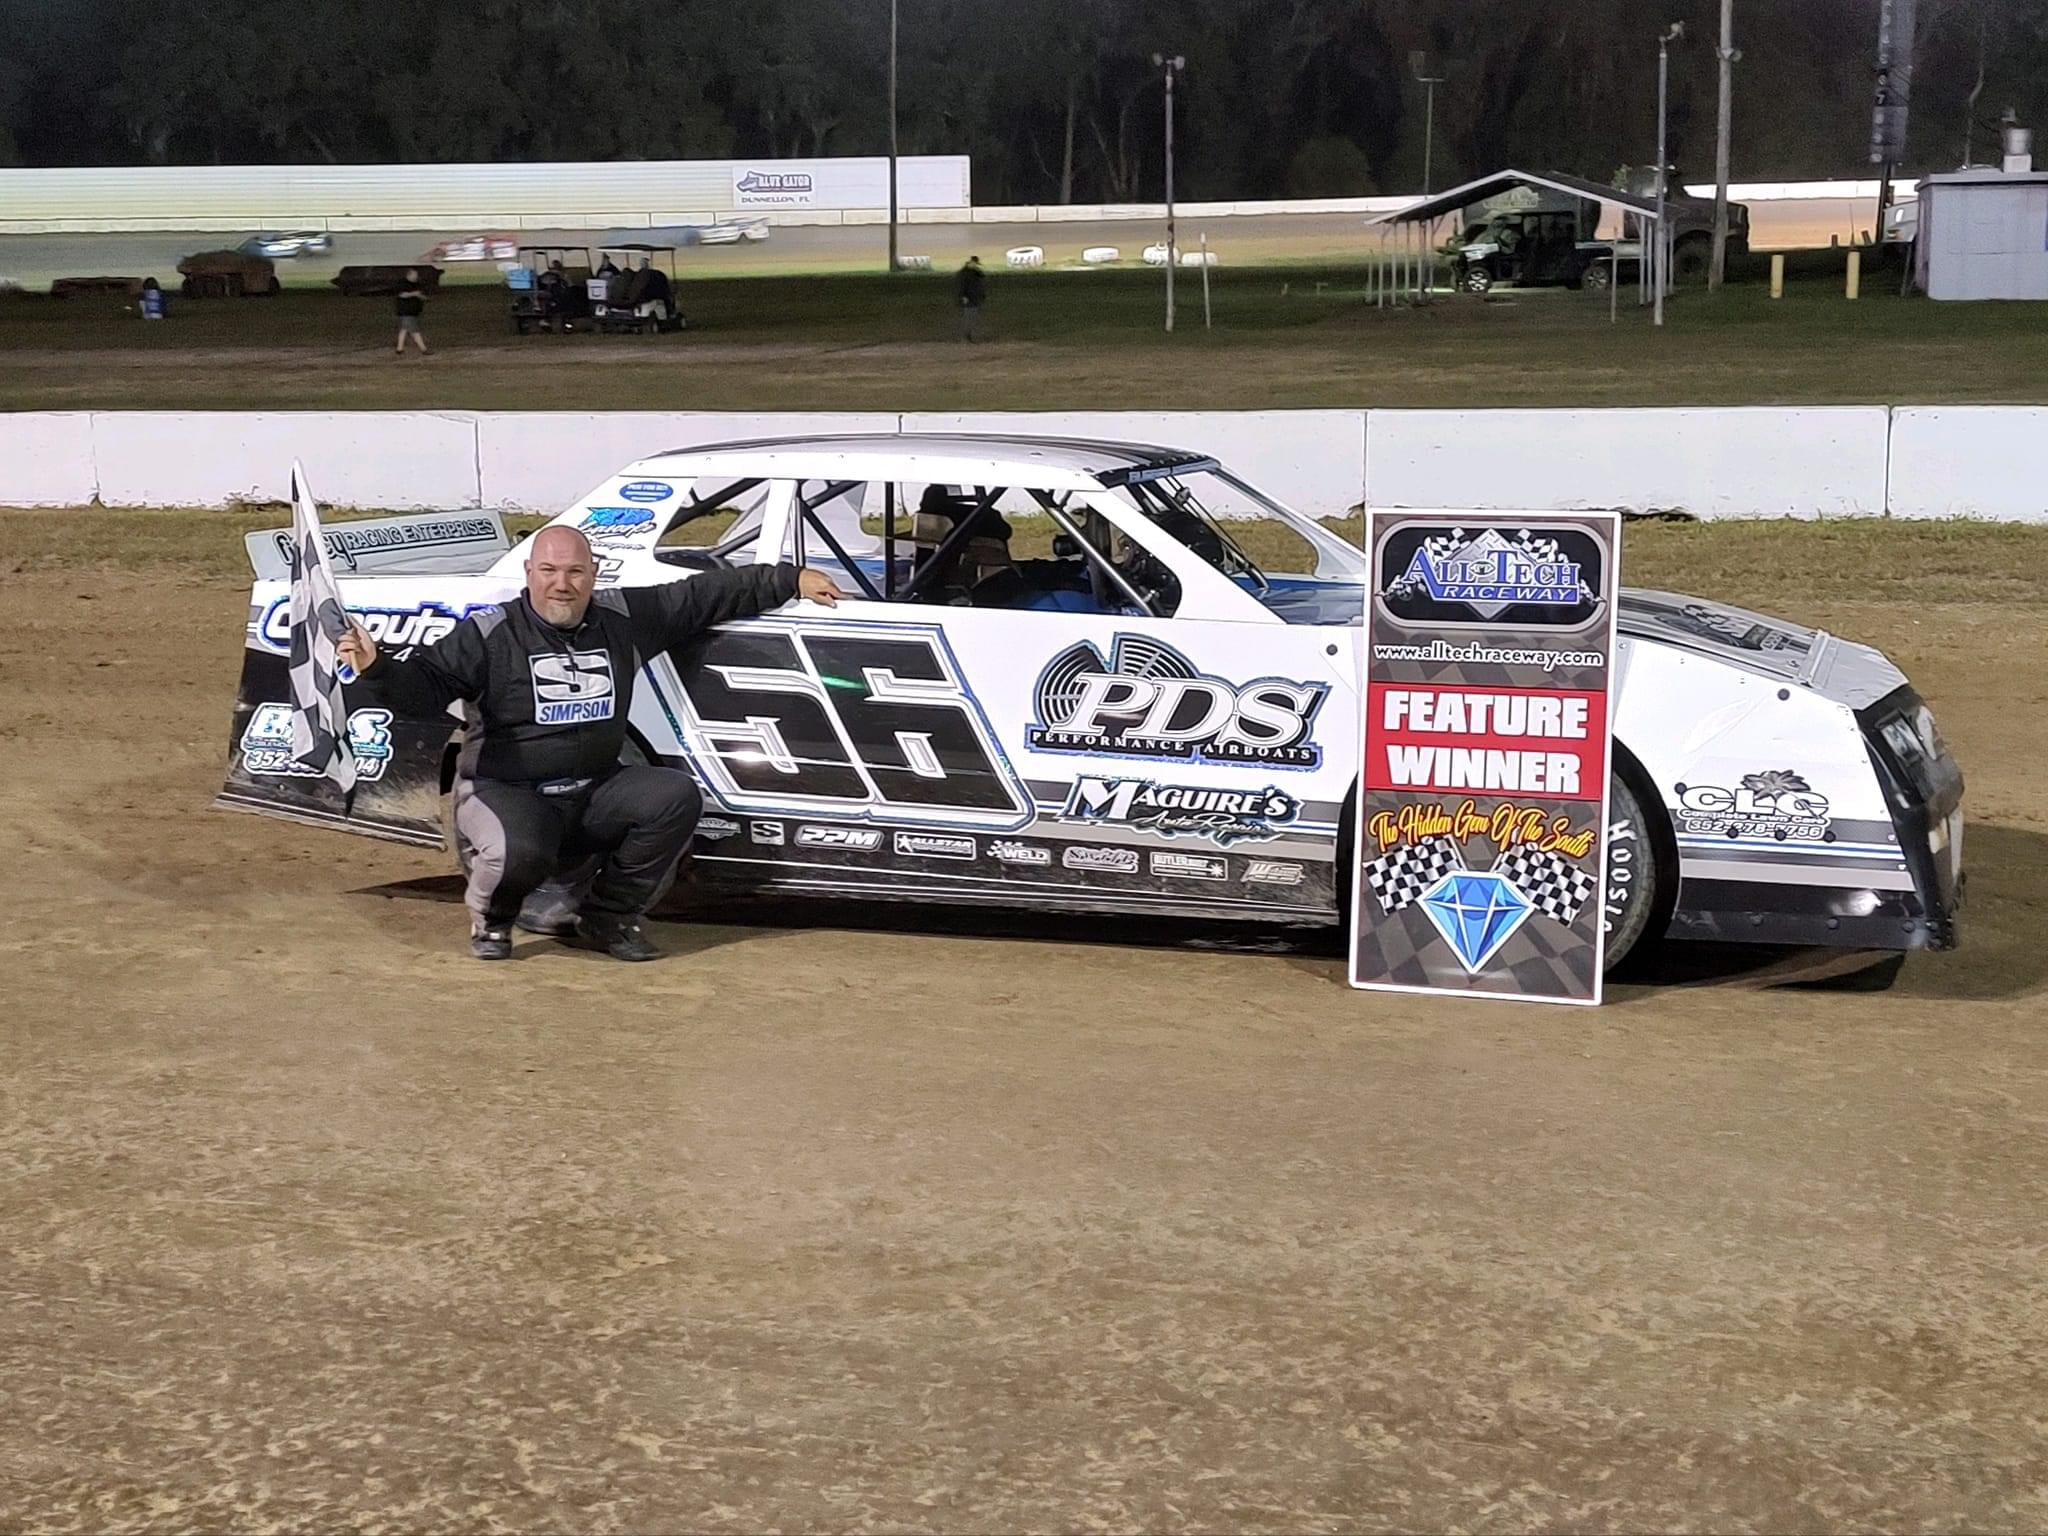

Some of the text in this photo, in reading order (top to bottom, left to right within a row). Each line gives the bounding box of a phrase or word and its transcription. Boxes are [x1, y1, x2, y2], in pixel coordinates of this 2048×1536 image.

[348, 527, 402, 550] RACING
[403, 518, 497, 543] ENTERPRISES
[1443, 586, 1573, 601] RACEWAY
[1375, 642, 1603, 671] www.alltechraceway.com
[540, 700, 611, 722] SIMPSON
[1052, 672, 1317, 748] PDS
[1384, 690, 1588, 738] FEATURE
[1032, 732, 1186, 751] PERFORMANCE
[1203, 744, 1311, 760] AIRBOATS
[1386, 745, 1581, 794] WINNER
[1069, 776, 1291, 820] MAGUIRE'S
[1681, 786, 1829, 817] CLC
[1133, 810, 1193, 829] Auto
[1369, 799, 1597, 858] The Hidden Gem Of The South
[1681, 809, 1827, 824] Complete Lawn Care
[802, 828, 876, 845] PPM
[1003, 847, 1048, 860] WELD
